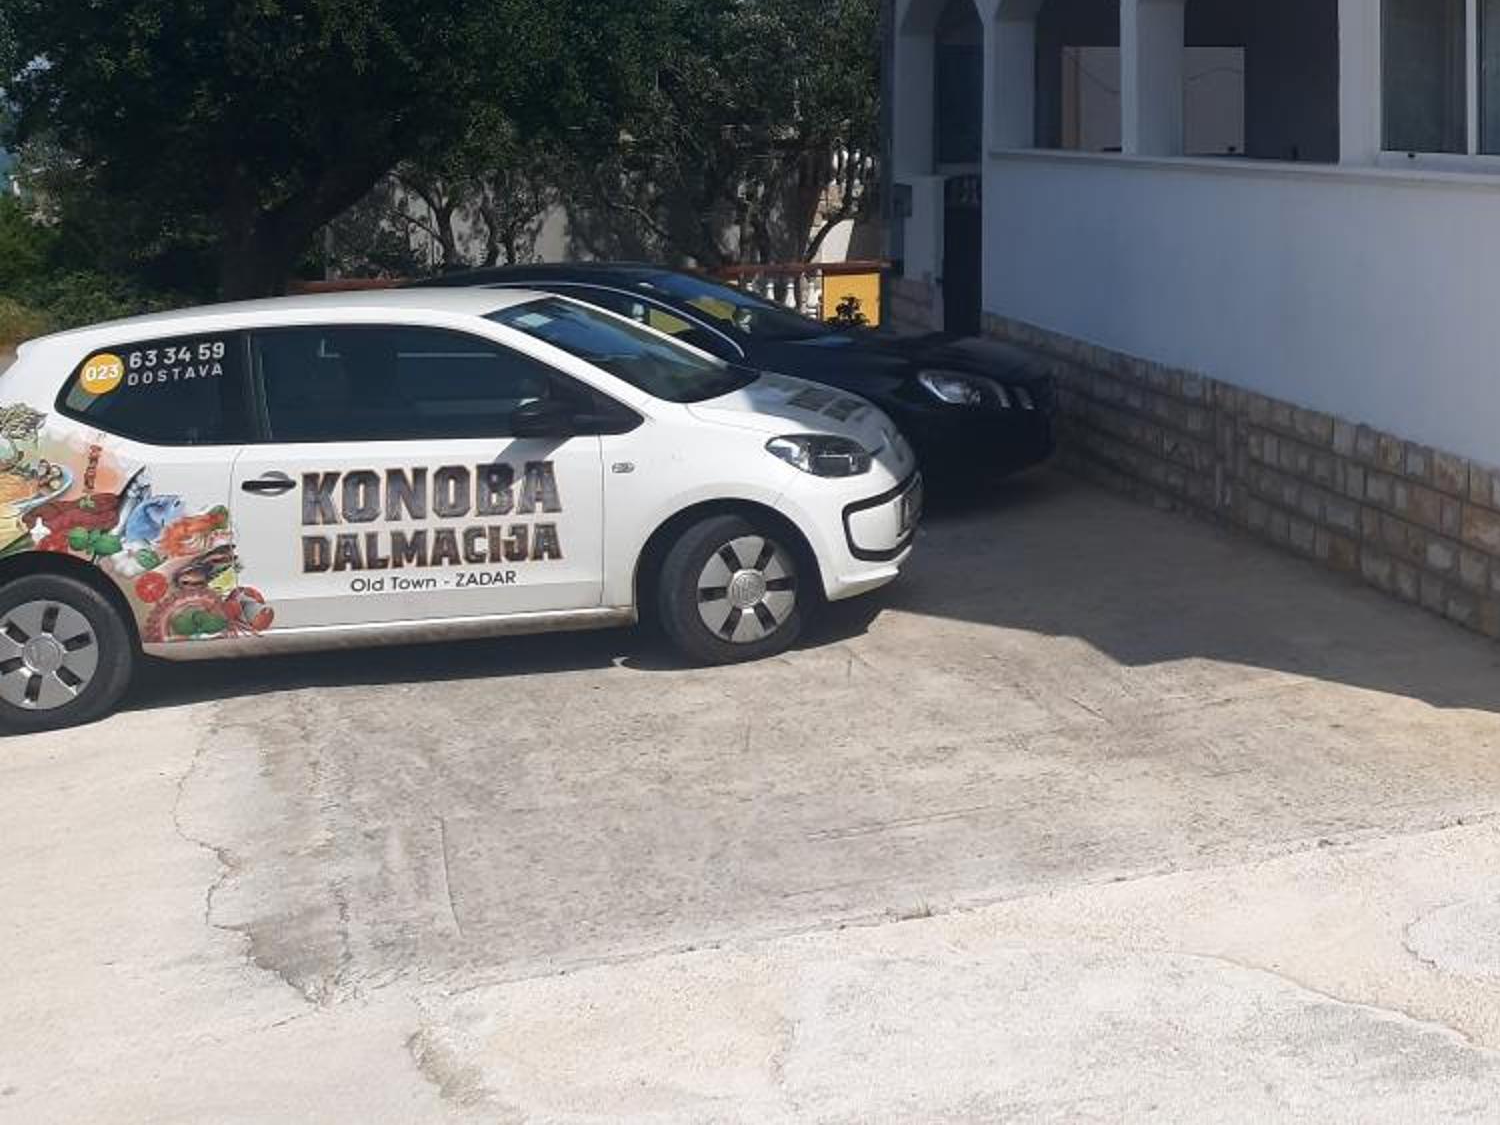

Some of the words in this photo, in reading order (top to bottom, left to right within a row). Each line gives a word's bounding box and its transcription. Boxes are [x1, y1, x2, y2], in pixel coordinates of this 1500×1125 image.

[129, 348, 158, 369] 63
[163, 347, 192, 364] 34
[198, 342, 225, 360] 59
[85, 364, 119, 381] 023
[127, 362, 223, 386] DOSTAVA
[301, 460, 563, 526] KONOBA
[301, 523, 563, 573] DALMACIJA
[350, 578, 385, 593] Old
[391, 577, 438, 591] Town
[455, 570, 517, 588] ZADAR
